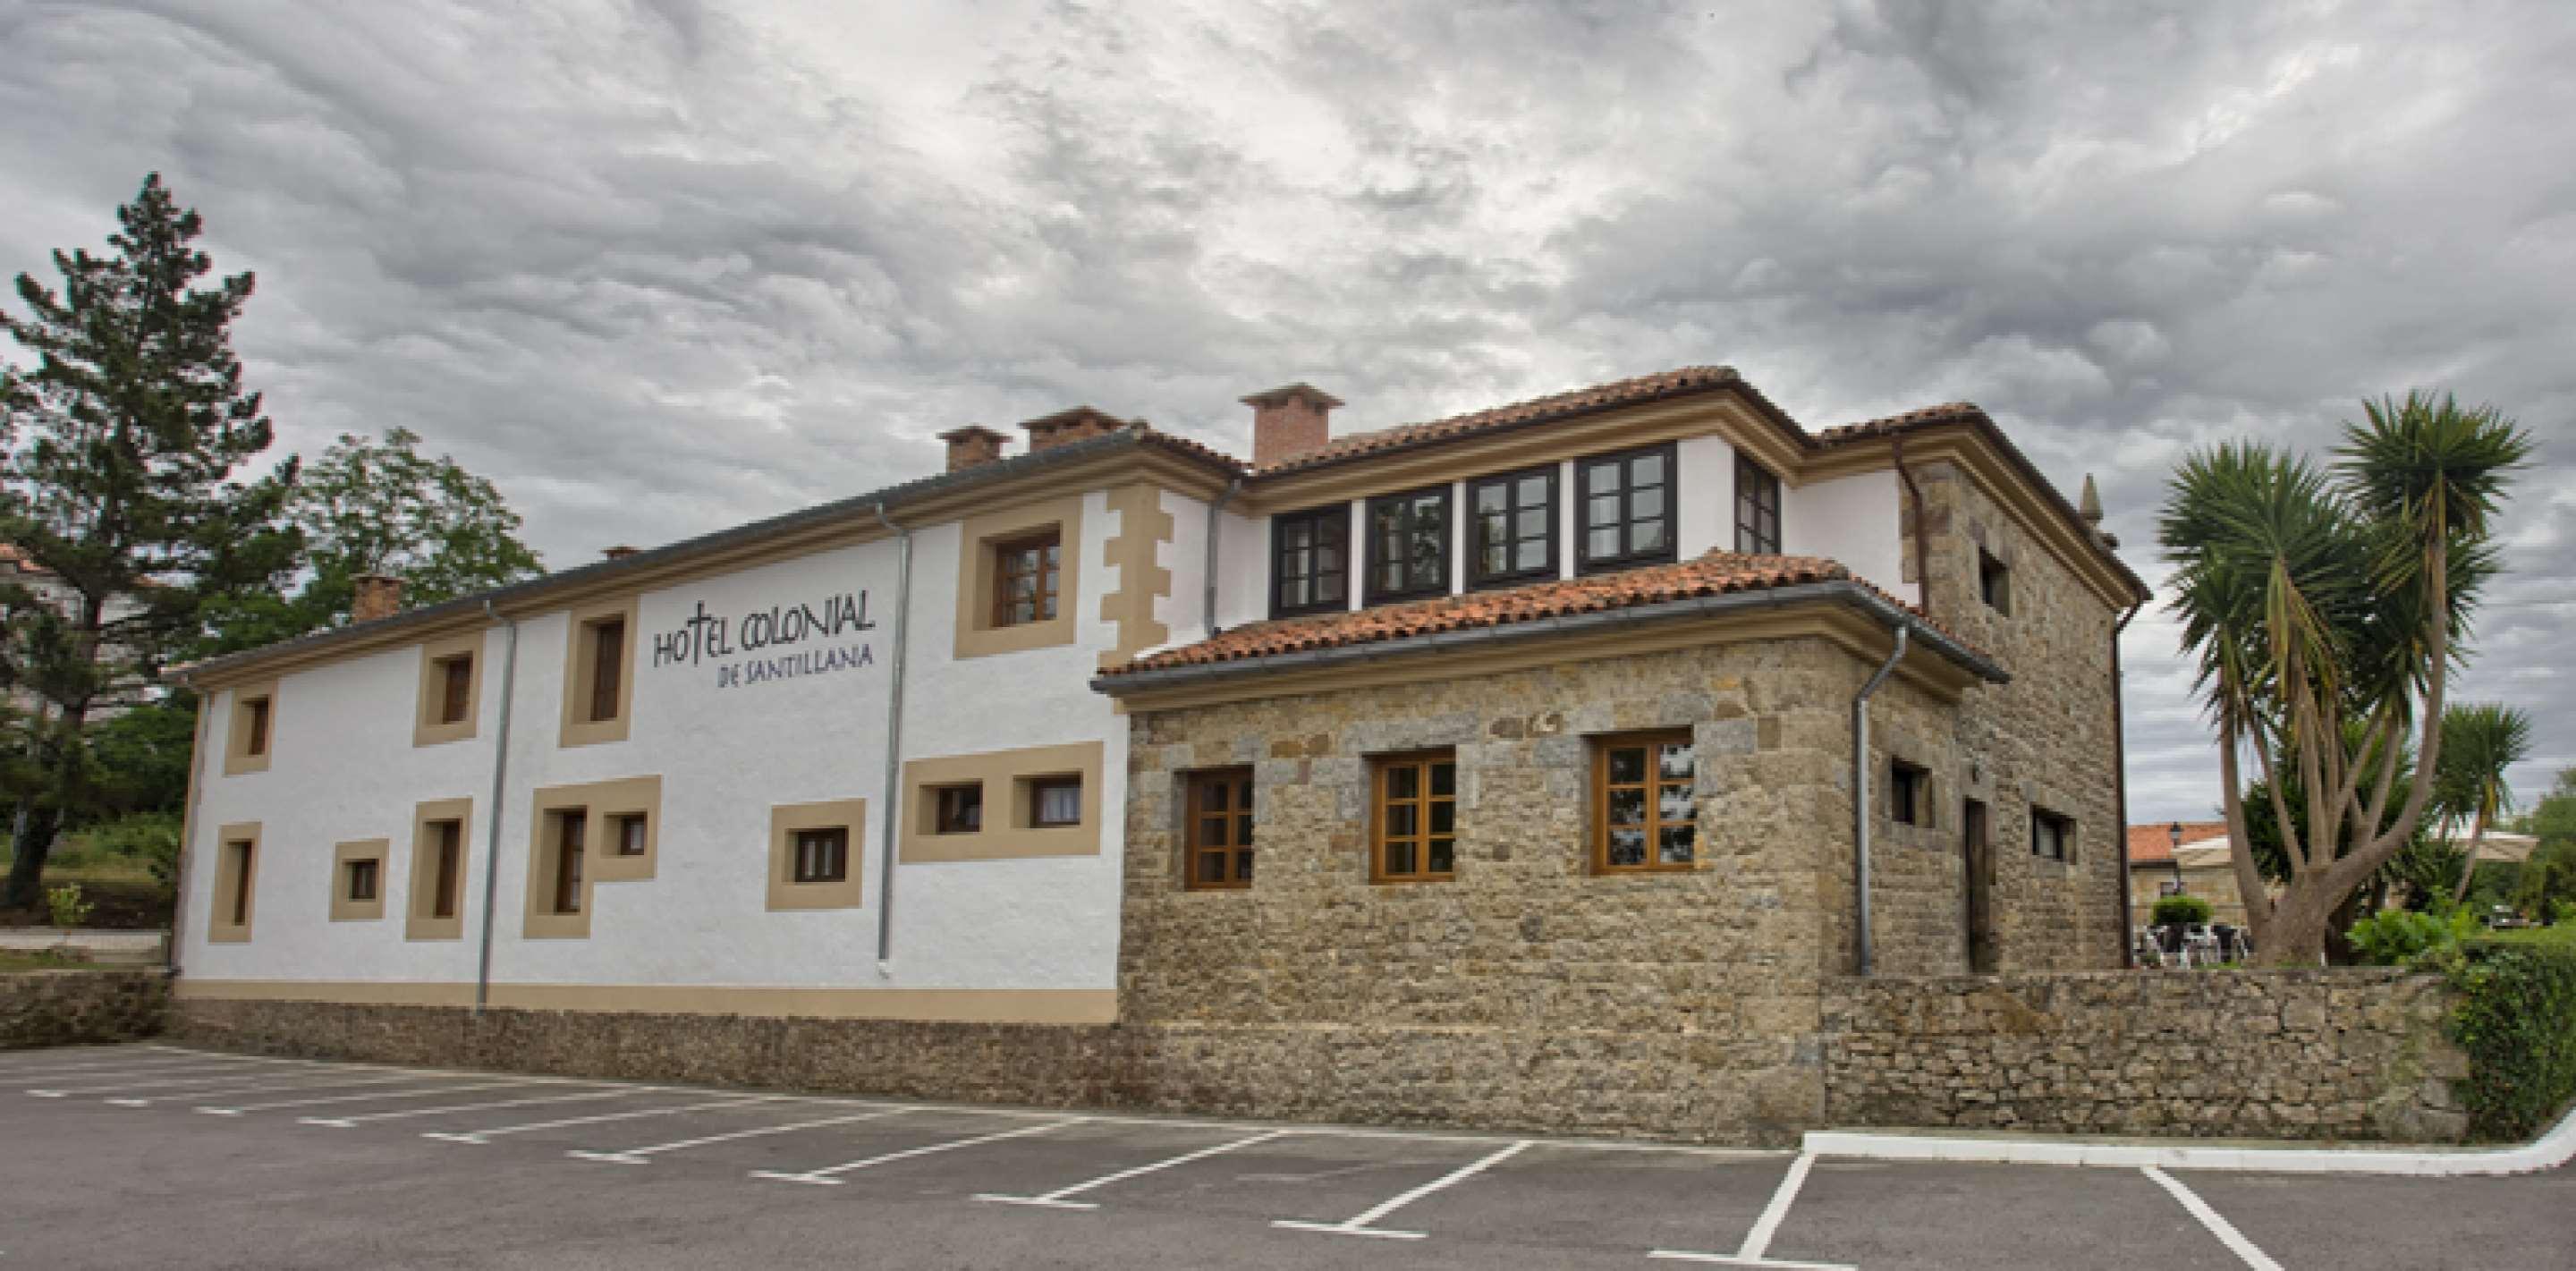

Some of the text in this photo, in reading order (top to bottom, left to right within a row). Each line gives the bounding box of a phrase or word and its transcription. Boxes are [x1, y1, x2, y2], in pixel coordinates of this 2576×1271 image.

[654, 589, 876, 667] HOTEL COLONIAL
[717, 643, 873, 688] DE SANTILLANA
